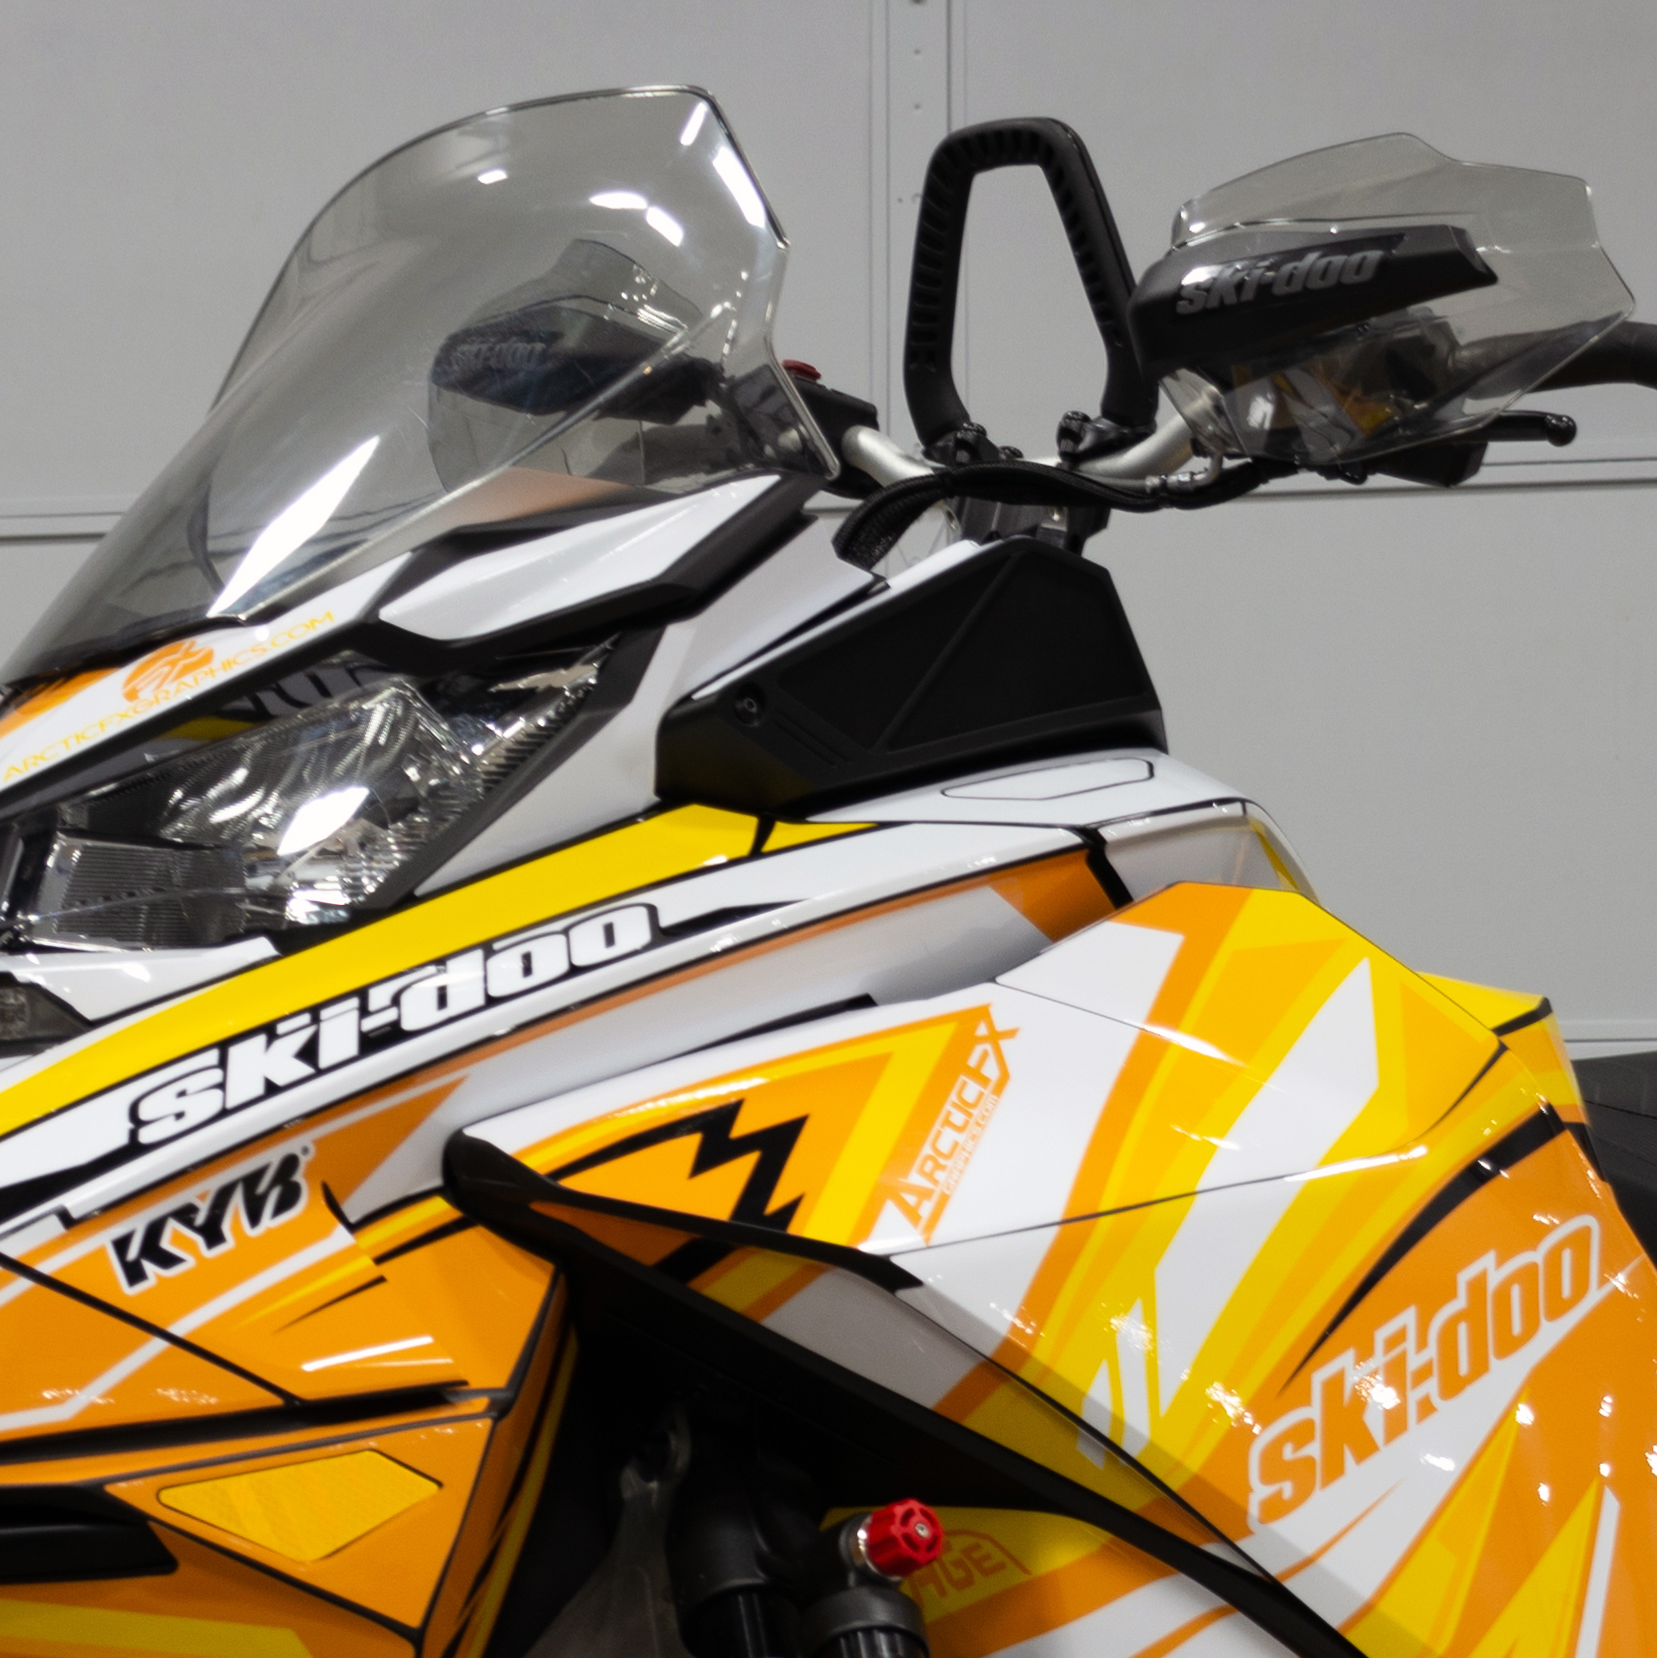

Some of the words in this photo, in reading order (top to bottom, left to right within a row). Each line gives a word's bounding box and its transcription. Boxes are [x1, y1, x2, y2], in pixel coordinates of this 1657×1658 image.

[1175, 248, 1385, 314] ski-doo
[3, 611, 335, 783] ARCTICFXGRAPHICS.COM
[138, 903, 653, 1145] ski-doo
[109, 1151, 303, 1289] KYB
[1250, 1216, 1599, 1532] ski-doo
